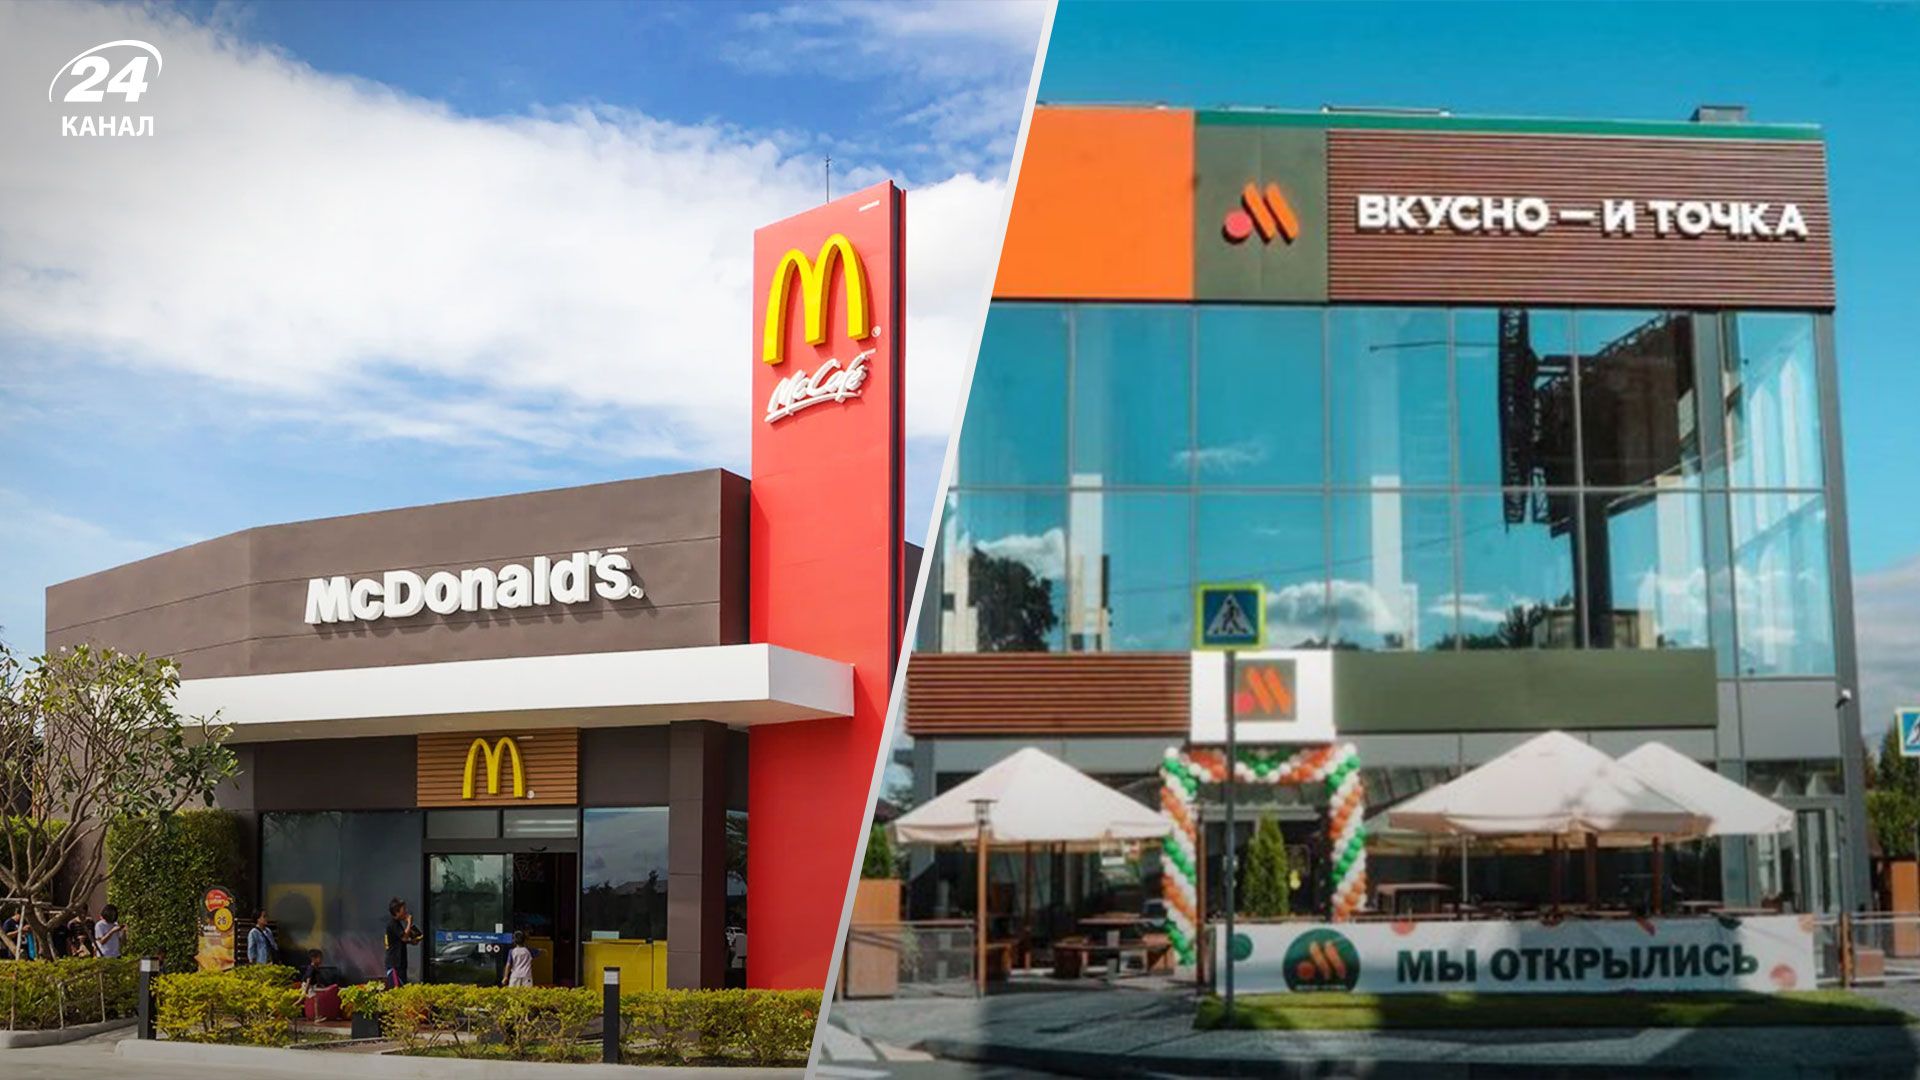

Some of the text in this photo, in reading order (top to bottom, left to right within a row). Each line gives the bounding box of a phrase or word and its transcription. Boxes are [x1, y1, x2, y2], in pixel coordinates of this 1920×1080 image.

[1358, 194, 1550, 232] ВКУСНО
[1602, 199, 1636, 233] И
[1648, 200, 1809, 236] ТОЧКА
[304, 551, 632, 625] McDonald's
[1397, 943, 1759, 982] МЫ ОТКРЫЛИСЬ
